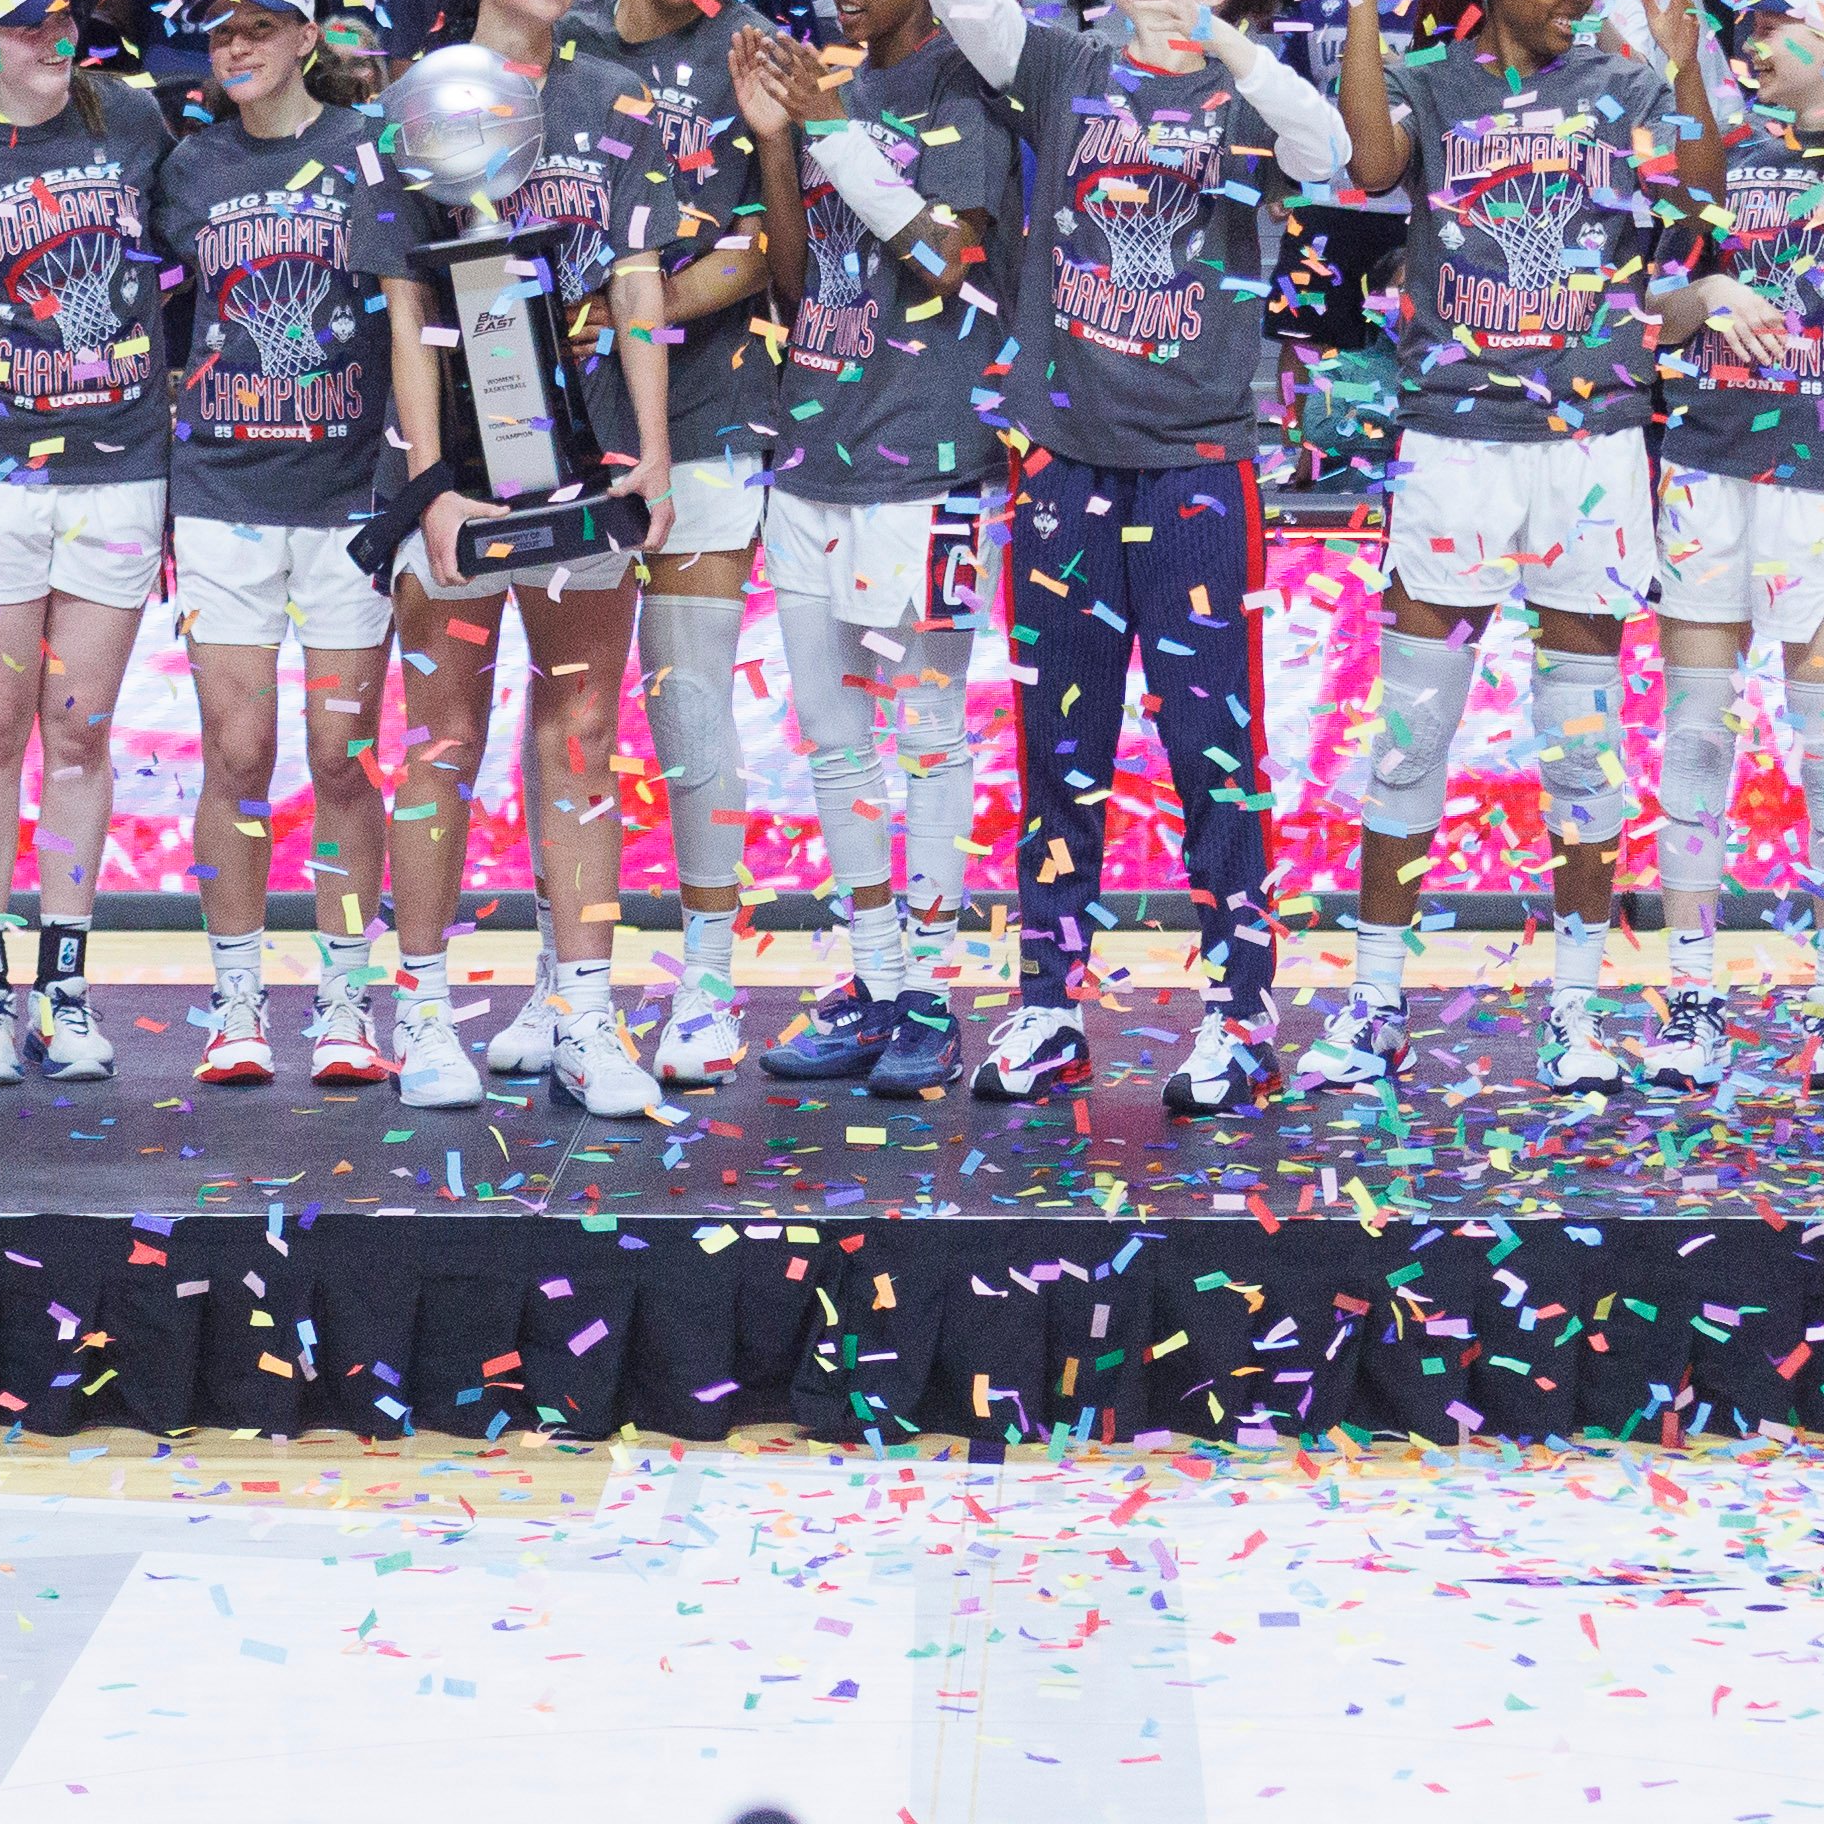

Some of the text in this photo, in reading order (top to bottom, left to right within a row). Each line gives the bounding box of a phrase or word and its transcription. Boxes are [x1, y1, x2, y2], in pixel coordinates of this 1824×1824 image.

[1442, 130, 1617, 191] TOURNAMENT
[40, 162, 123, 185] EAST
[1727, 166, 1776, 182] BIG
[208, 193, 260, 219] BIG
[265, 190, 347, 216] EAST
[195, 218, 354, 292] TOURNAMEN
[1052, 246, 1205, 341] CHAMPIONS
[1438, 262, 1597, 332] CHAMPIONS
[474, 317, 516, 333] EAST
[1054, 313, 1070, 331] 25
[1082, 326, 1144, 356] UCONN
[1487, 334, 1553, 348] UCONN
[483, 382, 527, 395] BASKETBALL
[487, 375, 521, 385] WOMEN'S
[1699, 378, 1716, 390] 25
[1800, 380, 1822, 395] 26
[49, 391, 112, 408] UCONN
[200, 362, 363, 421] CHAMPIONS
[214, 424, 347, 439] 25 UCONN 26
[495, 431, 534, 443] CHAMPION
[943, 545, 974, 606] C
